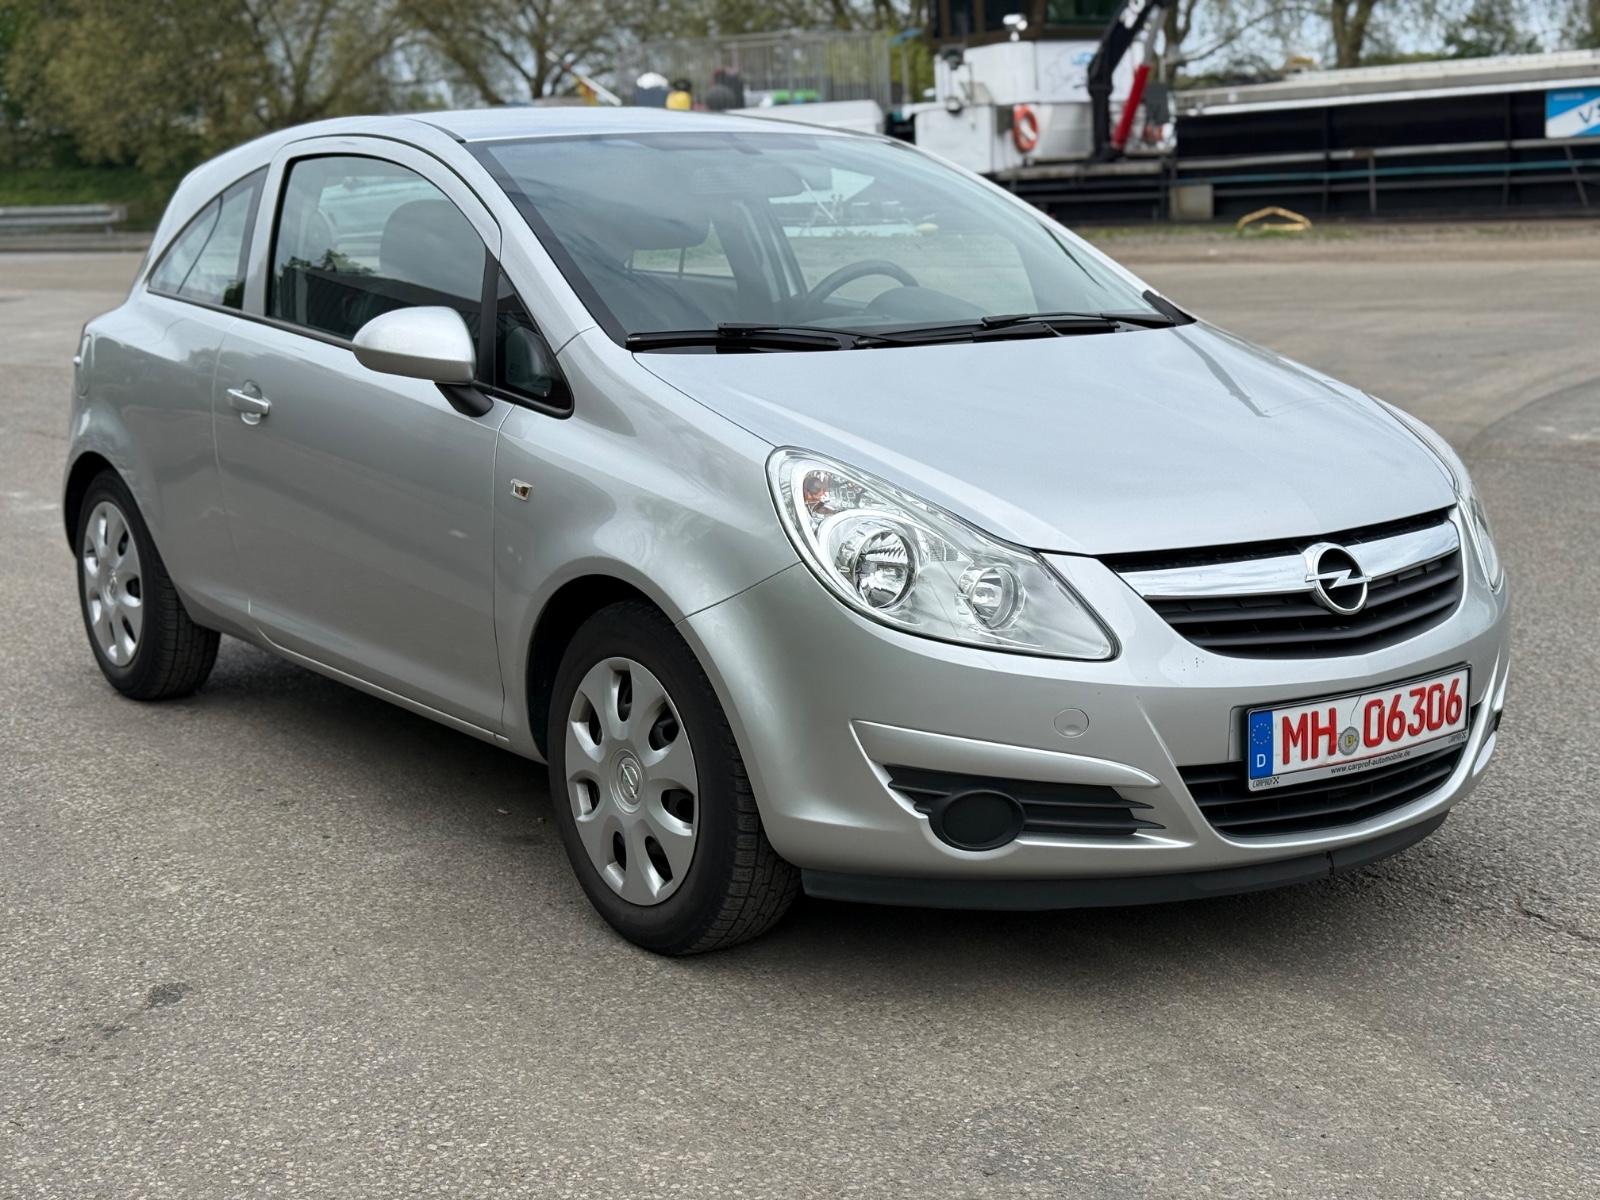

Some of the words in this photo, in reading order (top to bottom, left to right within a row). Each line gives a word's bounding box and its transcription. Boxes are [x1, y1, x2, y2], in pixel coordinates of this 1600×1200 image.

[1281, 707, 1337, 766] MH
[1363, 678, 1463, 748] 06306
[1256, 753, 1266, 769] D
